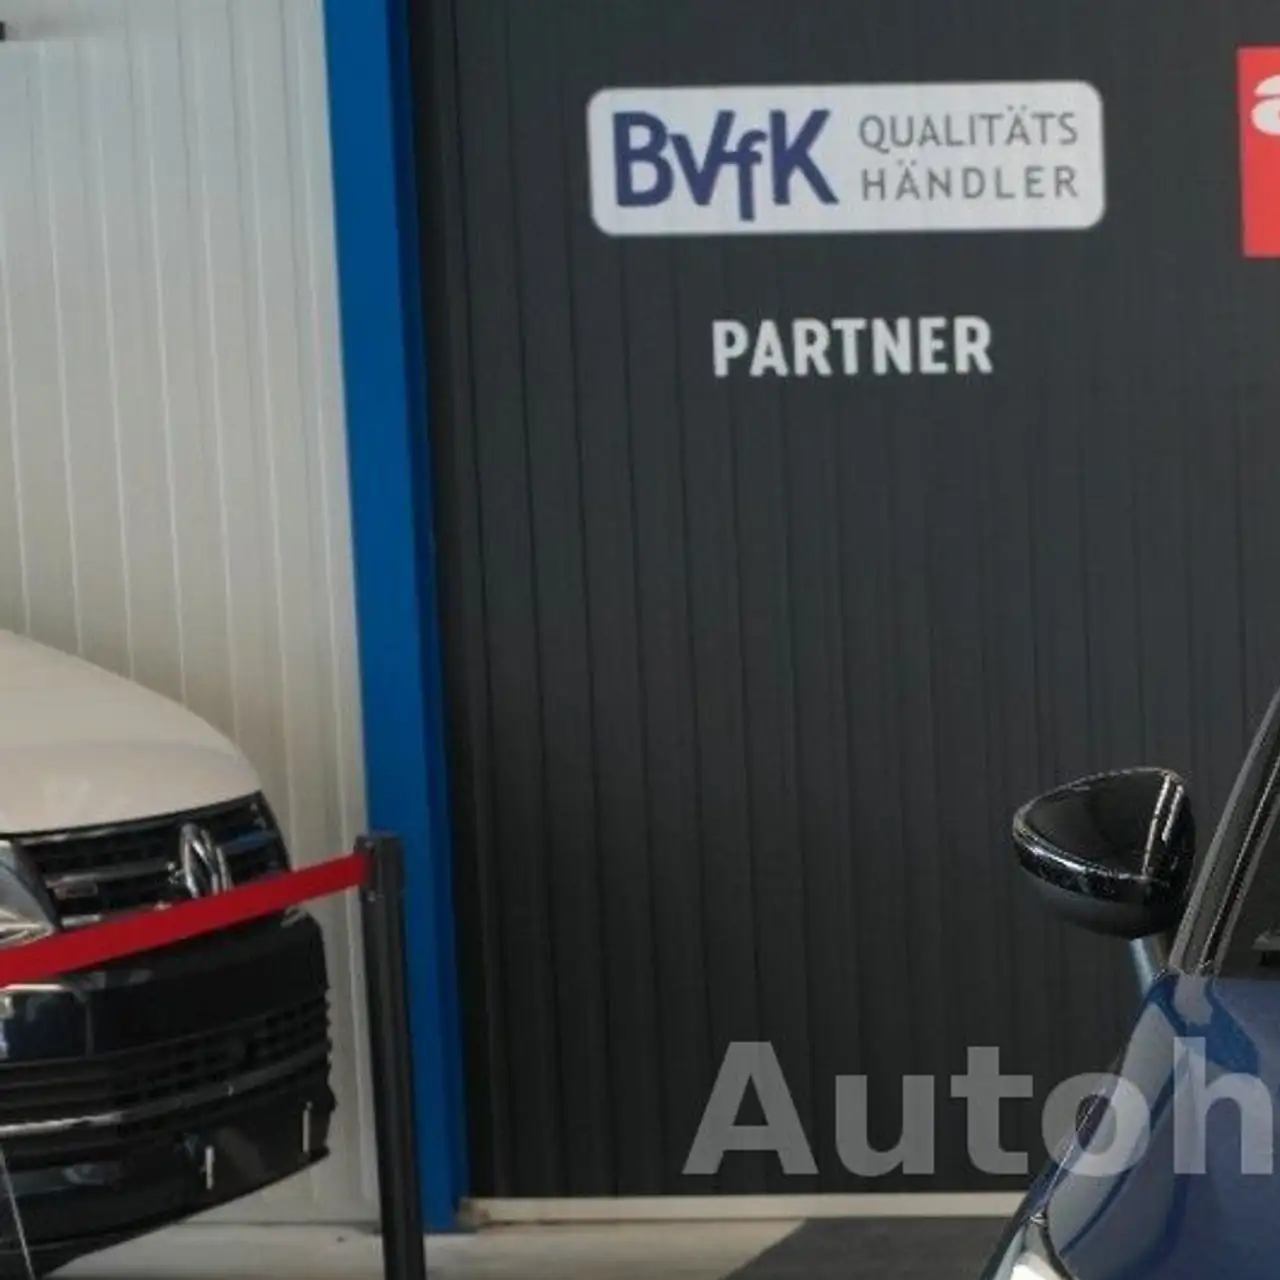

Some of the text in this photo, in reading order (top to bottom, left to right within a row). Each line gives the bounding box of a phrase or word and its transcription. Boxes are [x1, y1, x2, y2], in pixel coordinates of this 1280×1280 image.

[858, 104, 1078, 153] QUALITÄTS
[861, 156, 1079, 202] HÄNDLER
[711, 315, 994, 378] PARTNER
